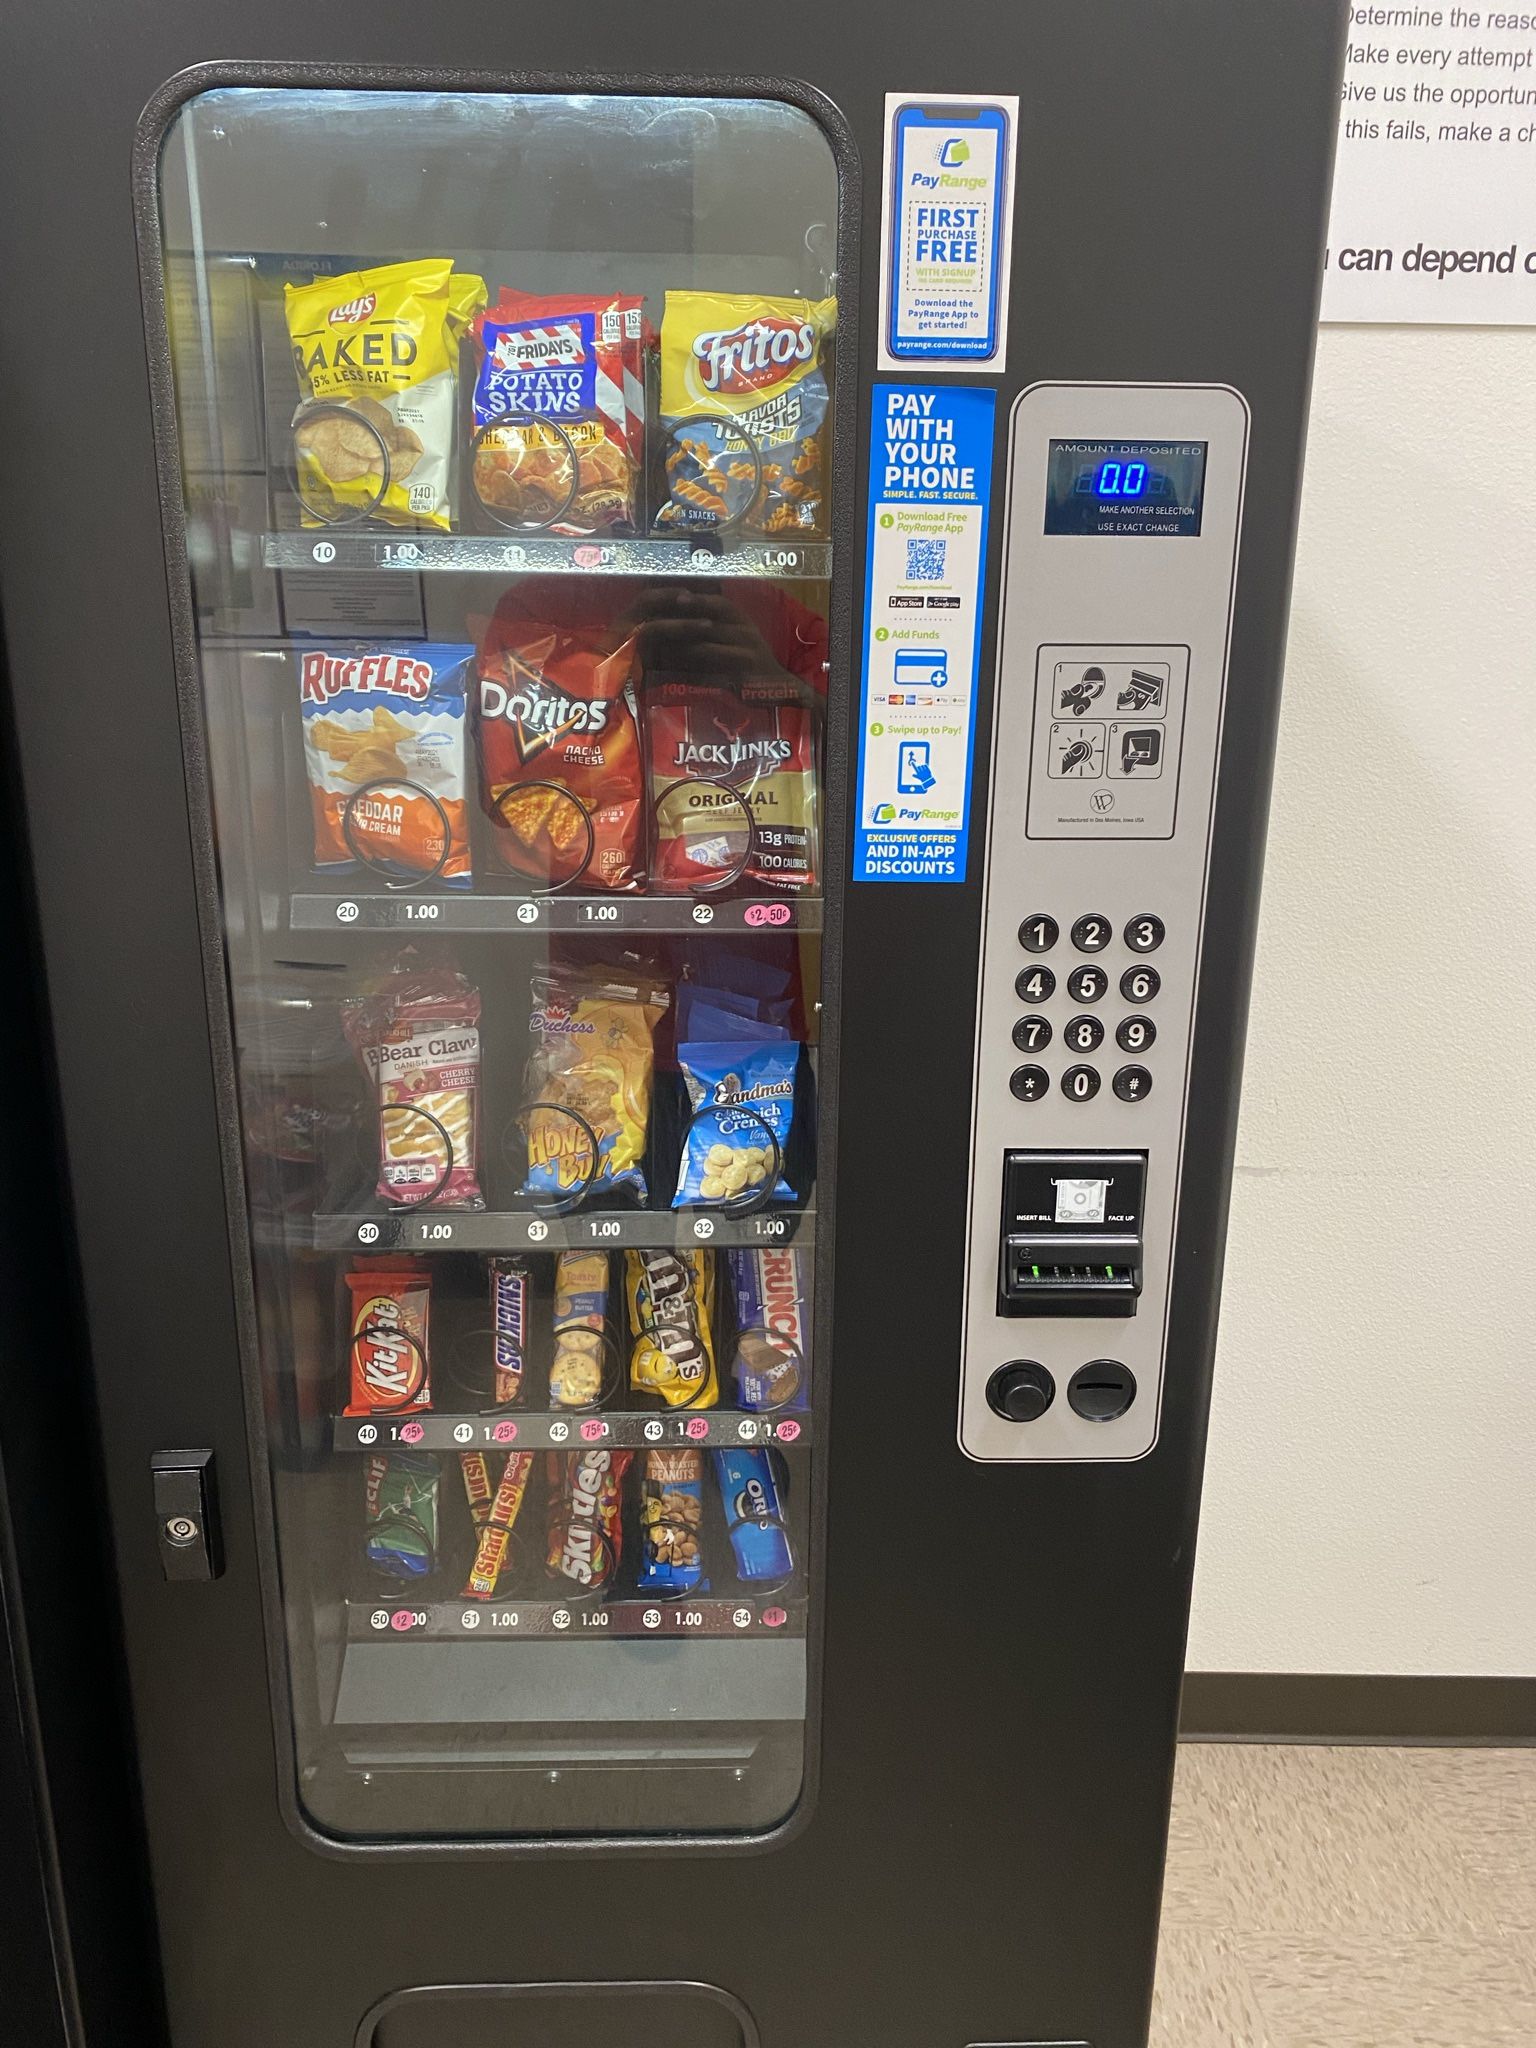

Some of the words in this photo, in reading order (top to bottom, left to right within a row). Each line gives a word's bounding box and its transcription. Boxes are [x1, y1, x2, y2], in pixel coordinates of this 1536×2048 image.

[1450, 7, 1481, 28] the
[1396, 48, 1452, 70] every
[1457, 49, 1533, 72] attempt
[1383, 85, 1407, 102] us
[1413, 82, 1444, 103] the
[1345, 119, 1380, 140] this
[1386, 120, 1431, 143] fails,
[1438, 122, 1492, 142] make
[1499, 126, 1511, 142] a
[910, 172, 987, 190] PayRange
[917, 207, 979, 228] FIRST
[917, 229, 977, 240] PURCHASE
[915, 240, 977, 263] FREE
[1338, 248, 1393, 271] can
[1402, 243, 1517, 280] depend
[915, 267, 937, 276] WITH
[941, 268, 976, 277] SIGNUP
[914, 298, 957, 307] Download
[959, 299, 973, 308] the
[908, 309, 949, 319] PayRange
[951, 310, 968, 319] App
[918, 322, 932, 330] get
[933, 321, 967, 329] started!
[516, 339, 573, 360] FRIDAYS
[897, 341, 988, 349] payrange.com/download
[692, 323, 815, 390] Fritos
[334, 370, 364, 384] LESS
[368, 370, 390, 384] FAT
[487, 372, 583, 391] POTATO
[488, 391, 581, 413] SKINS
[887, 393, 936, 416] PAY
[886, 417, 953, 441] WITH
[884, 442, 957, 465] YOUR
[1055, 444, 1114, 454] AMOUNT
[1120, 445, 1201, 456] DEPOSITED
[884, 466, 975, 489] PHONE
[1099, 463, 1145, 494] 0.0
[413, 486, 431, 499] 140
[882, 490, 917, 499] SIMPLE.
[919, 490, 941, 499] FAST.
[943, 491, 978, 500] SECURE.
[688, 509, 716, 521] SNACKS
[897, 511, 945, 521] Download
[948, 512, 967, 521] Free
[1099, 505, 1119, 514] MAKE
[1120, 506, 1154, 515] ANOTHER
[1154, 507, 1195, 516] SELECTION
[896, 523, 943, 534] PayRange
[944, 523, 963, 535] App
[1097, 523, 1114, 531] USE
[1116, 523, 1143, 531] EXACT
[1145, 523, 1180, 532] CHANGE
[316, 547, 332, 558] 10
[383, 545, 418, 560] 1.00
[763, 551, 798, 567] 1.00
[891, 630, 910, 639] Add
[912, 630, 940, 639] Funds
[303, 652, 432, 702] RUFFLES
[480, 681, 607, 732] Doritos
[887, 725, 915, 735] Swipe
[917, 727, 929, 735] up
[941, 726, 962, 736] Pay!
[1053, 725, 1060, 733] 2
[1111, 725, 1118, 733] 3
[565, 745, 601, 755] NACHO
[673, 742, 729, 765] JACK
[729, 739, 792, 762] LINK'S
[563, 754, 605, 765] CHEESE
[688, 791, 778, 807] ORIGAL
[899, 808, 959, 821] PayRange
[369, 820, 401, 836] CREAM
[759, 831, 782, 846] 13g
[866, 833, 917, 843] EXCLUSIVE
[919, 834, 957, 844] OFFERS
[602, 852, 623, 864] 260
[866, 844, 899, 858] AND
[902, 845, 955, 858] IN-APP
[759, 855, 781, 868] 100
[783, 858, 807, 869] CALORIES
[865, 860, 956, 875] DISCOUNTS
[339, 906, 356, 918] 20
[405, 904, 439, 919] 1.00
[519, 907, 536, 919] 21
[585, 906, 618, 921] 1.00
[695, 908, 711, 920] 22
[1033, 922, 1045, 946] 1
[1084, 922, 1100, 945] 2
[1136, 922, 1154, 947] 3
[1026, 973, 1043, 997] 4
[1080, 973, 1096, 997] 5
[1132, 973, 1150, 998] 6
[529, 1012, 596, 1034] Duchess
[1026, 1024, 1041, 1047] 7
[1077, 1023, 1092, 1047] 8
[1127, 1023, 1145, 1047] 9
[380, 1044, 422, 1063] Bear
[428, 1037, 477, 1056] Claw
[394, 1059, 428, 1071] DANISH
[440, 1067, 476, 1079] CHERRY
[441, 1076, 476, 1088] CHEESE
[1074, 1073, 1088, 1096] 0
[360, 1227, 377, 1239] 30
[421, 1225, 452, 1239] 1.00
[530, 1225, 545, 1236] 31
[590, 1222, 621, 1237] 1.00
[695, 1222, 712, 1234] 32
[754, 1221, 785, 1235] 1.00
[360, 1428, 376, 1439] 40
[456, 1427, 470, 1438] 41
[551, 1426, 567, 1437] 42
[646, 1425, 661, 1436] 43
[740, 1424, 755, 1435] 44
[368, 1459, 387, 1501] CLIF
[651, 1469, 695, 1481] PEANUTS
[475, 1482, 519, 1577] Starurst
[373, 1614, 388, 1624] 50
[463, 1614, 478, 1624] 51
[491, 1613, 519, 1626] 1.00
[554, 1614, 569, 1624] 52
[581, 1612, 608, 1626] 1.00
[644, 1613, 659, 1623] 53
[674, 1612, 702, 1625] 1.00
[734, 1613, 750, 1623] 54
